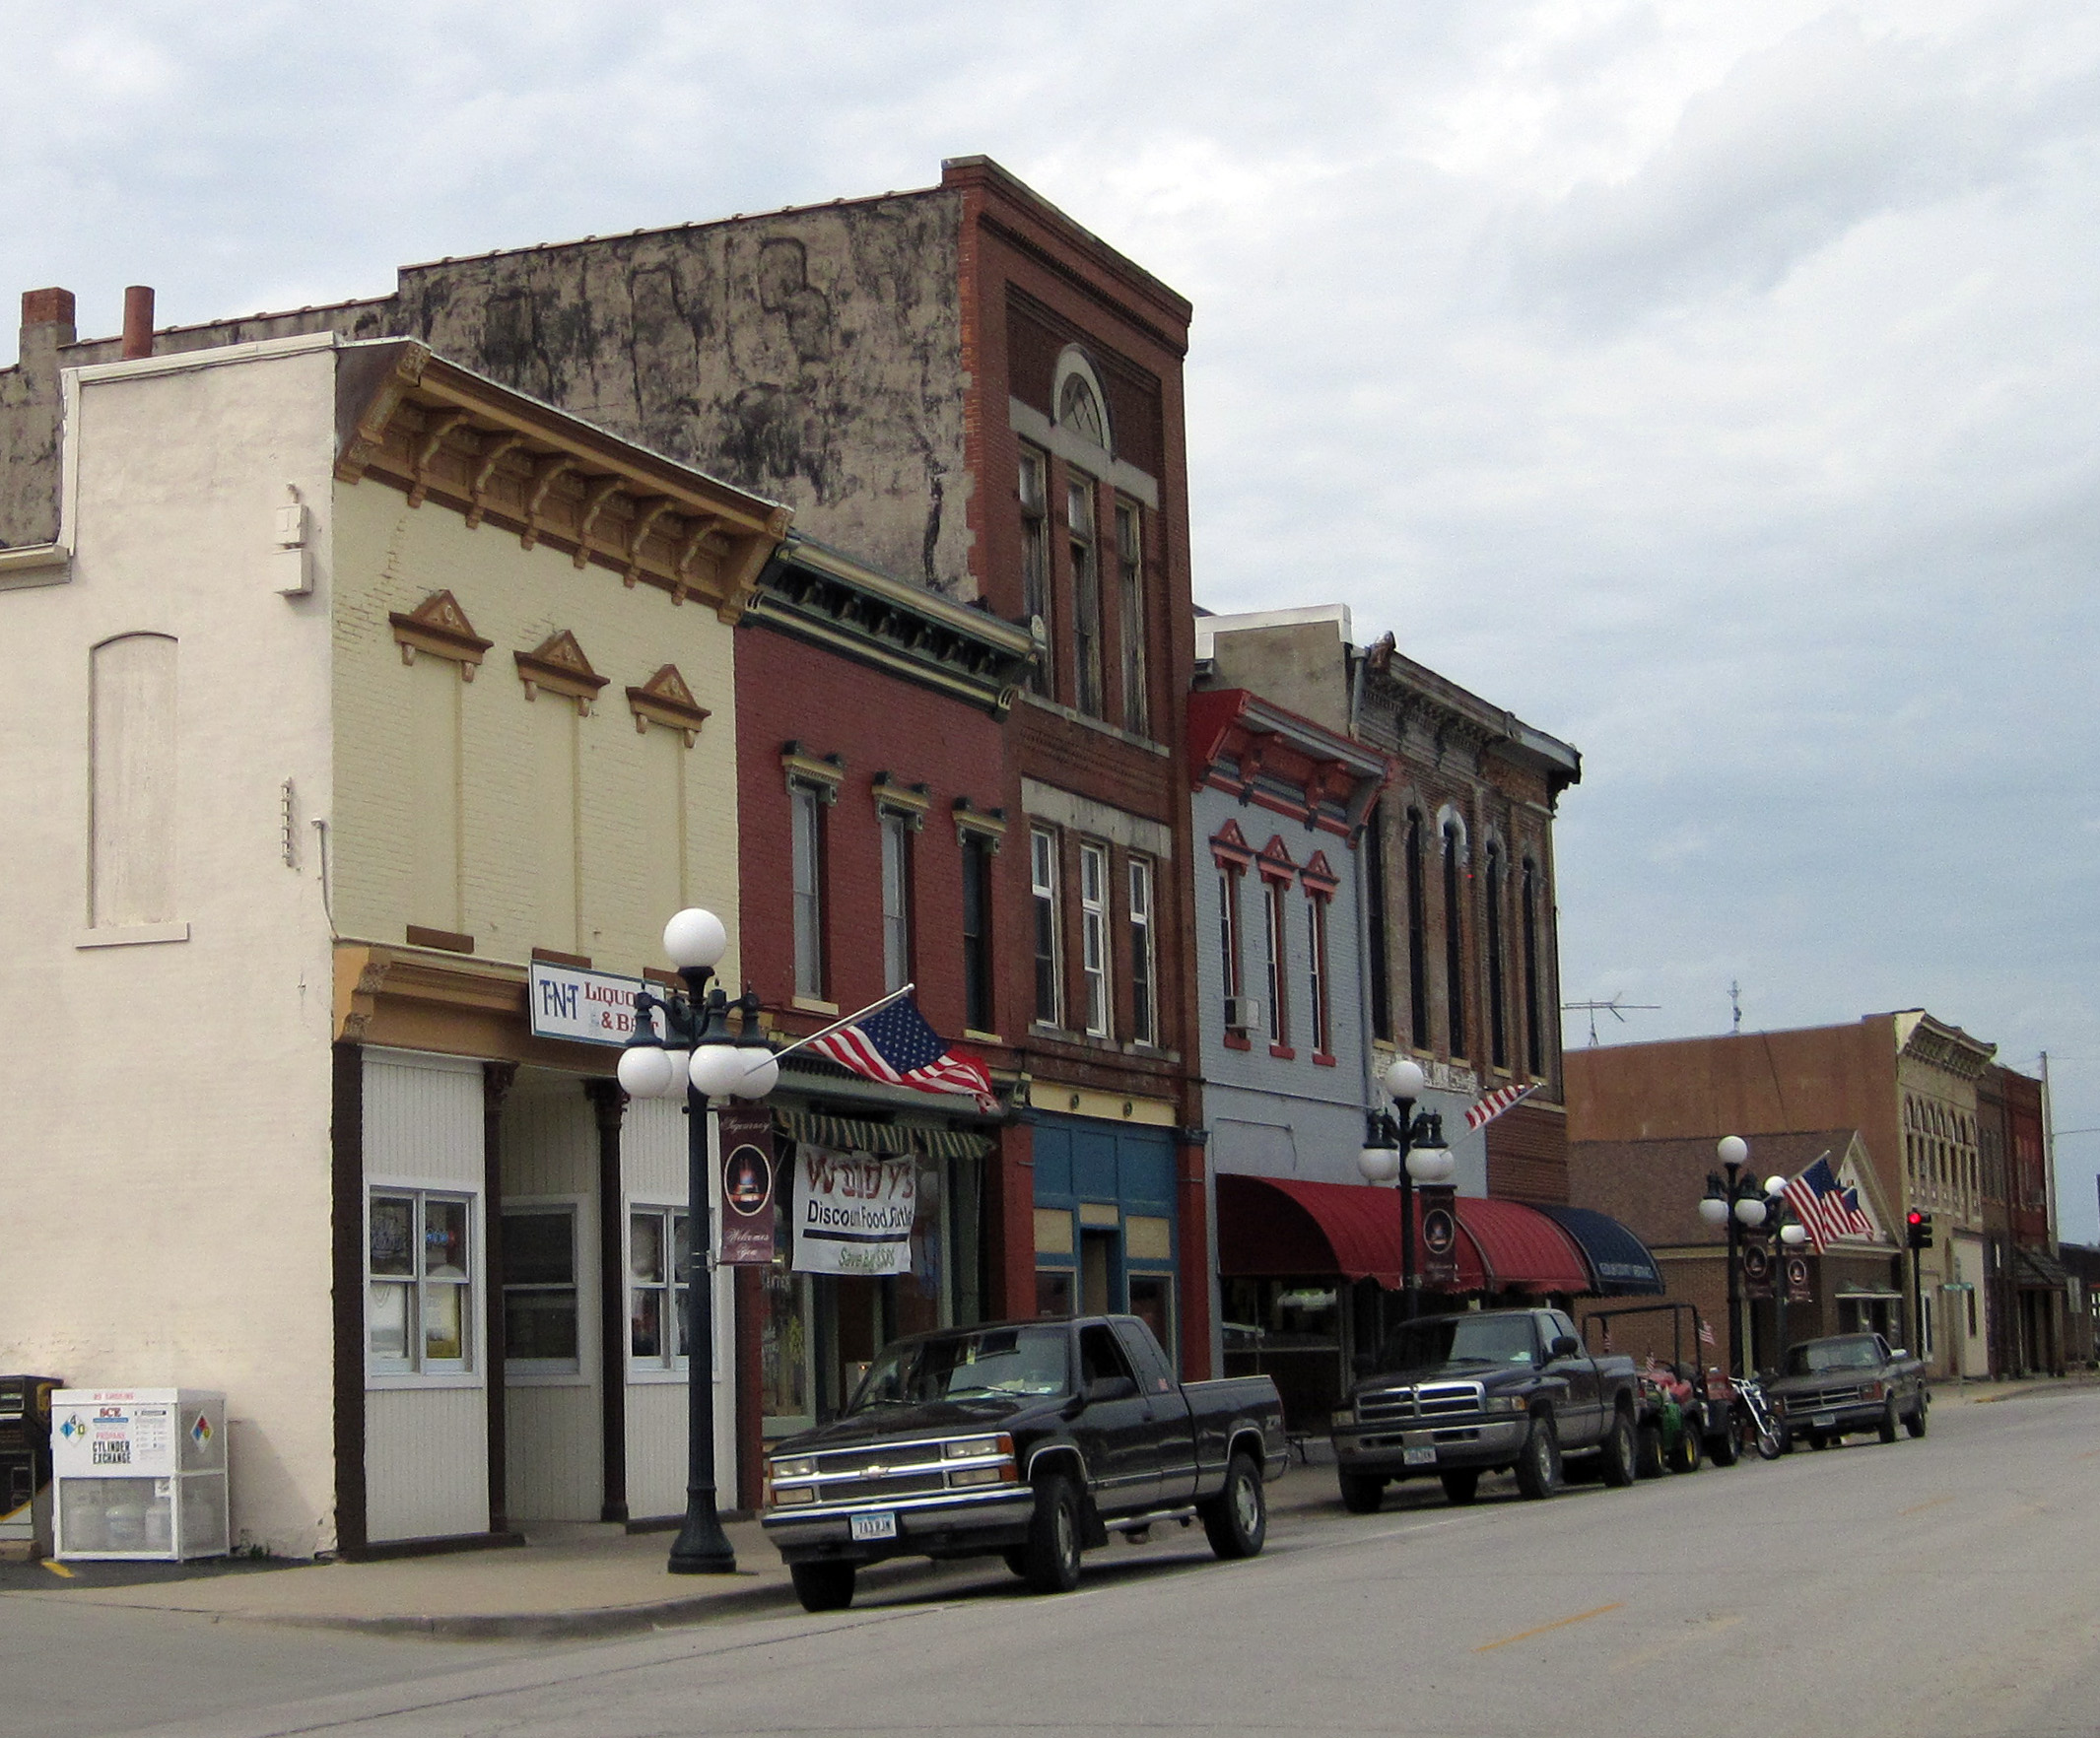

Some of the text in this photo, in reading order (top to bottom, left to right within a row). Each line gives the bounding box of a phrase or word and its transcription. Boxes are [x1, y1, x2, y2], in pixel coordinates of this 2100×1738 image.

[584, 981, 637, 1007] LIQUO
[602, 1011, 614, 1030] &
[807, 1199, 860, 1227] Discou
[861, 1206, 887, 1229] Food
[69, 1415, 76, 1426] 4
[93, 1440, 130, 1453] CYLINDER
[93, 1453, 131, 1465] EXCHANGE
